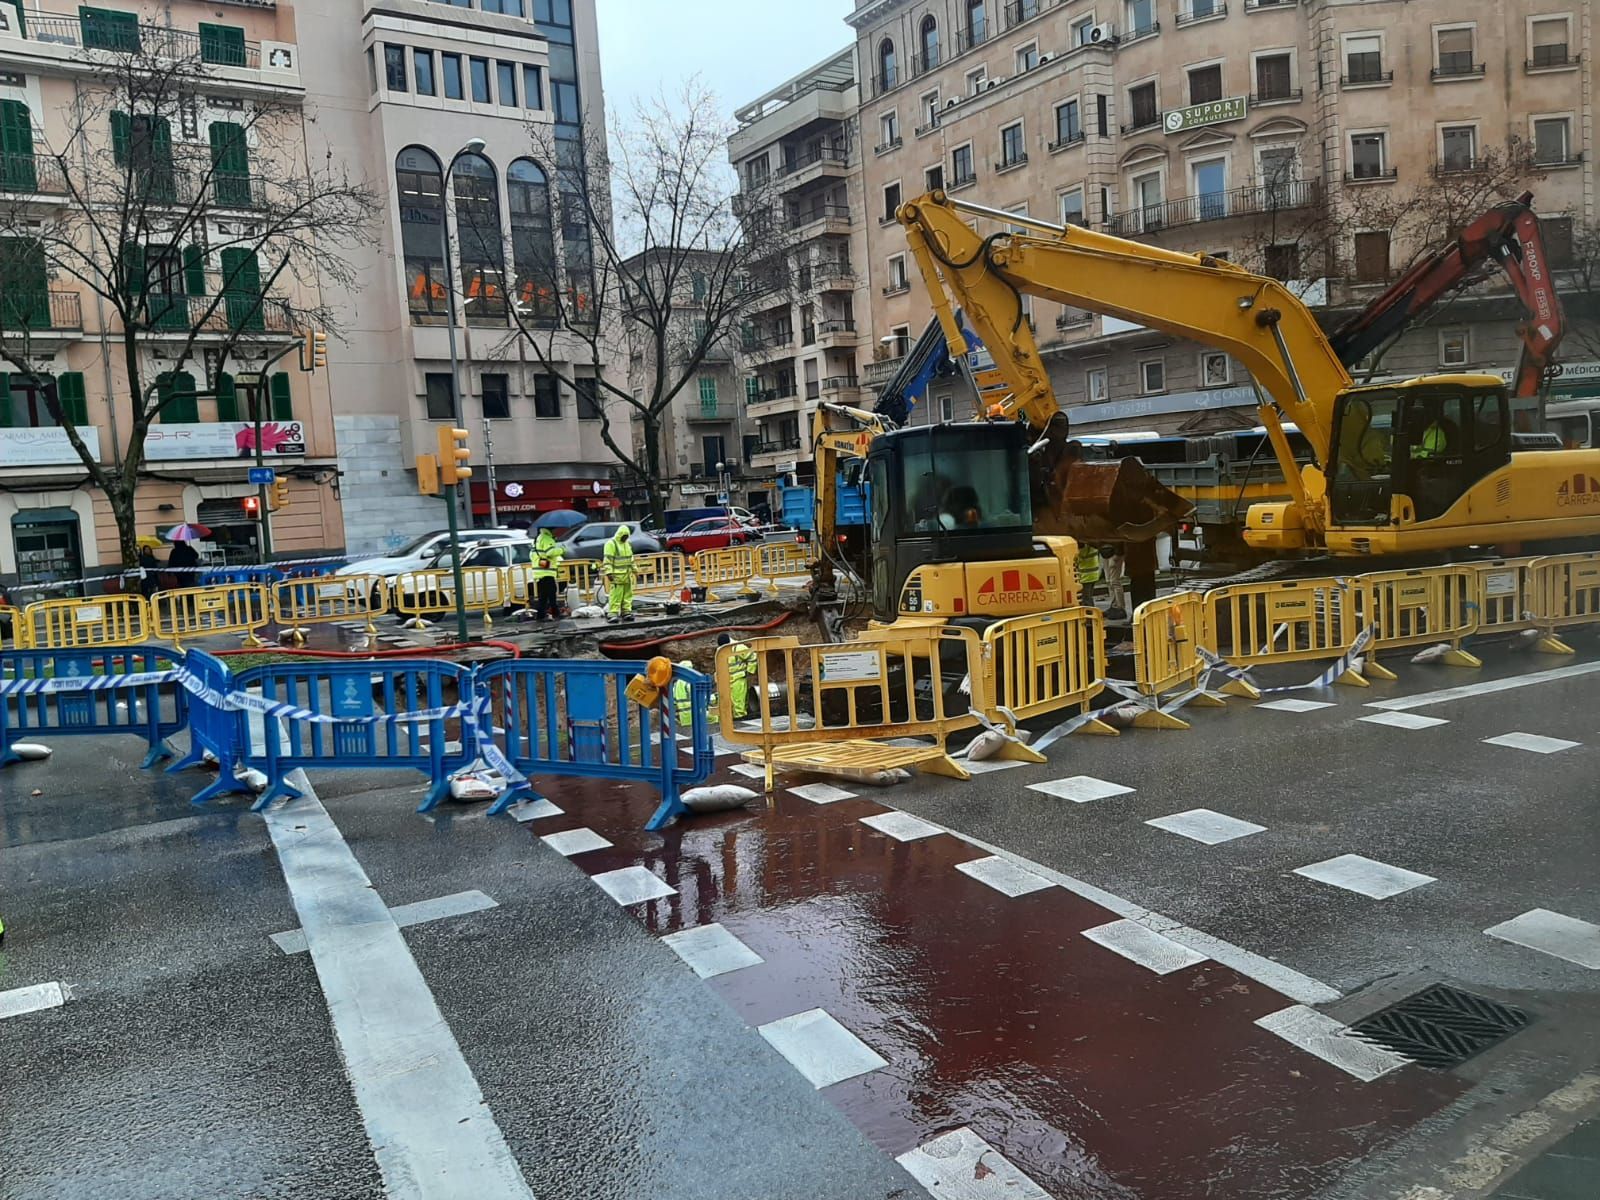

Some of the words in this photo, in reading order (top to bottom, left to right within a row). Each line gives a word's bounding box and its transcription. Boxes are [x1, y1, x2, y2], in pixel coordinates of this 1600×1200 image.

[1185, 100, 1240, 119] SUPORT
[1565, 365, 1600, 376] MÉDICO
[1213, 387, 1255, 401] CONFI
[147, 430, 191, 441] SHR
[1556, 493, 1600, 507] CARRERA
[497, 504, 536, 512] WEBUY.COM
[977, 591, 1047, 606] CARRERAS
